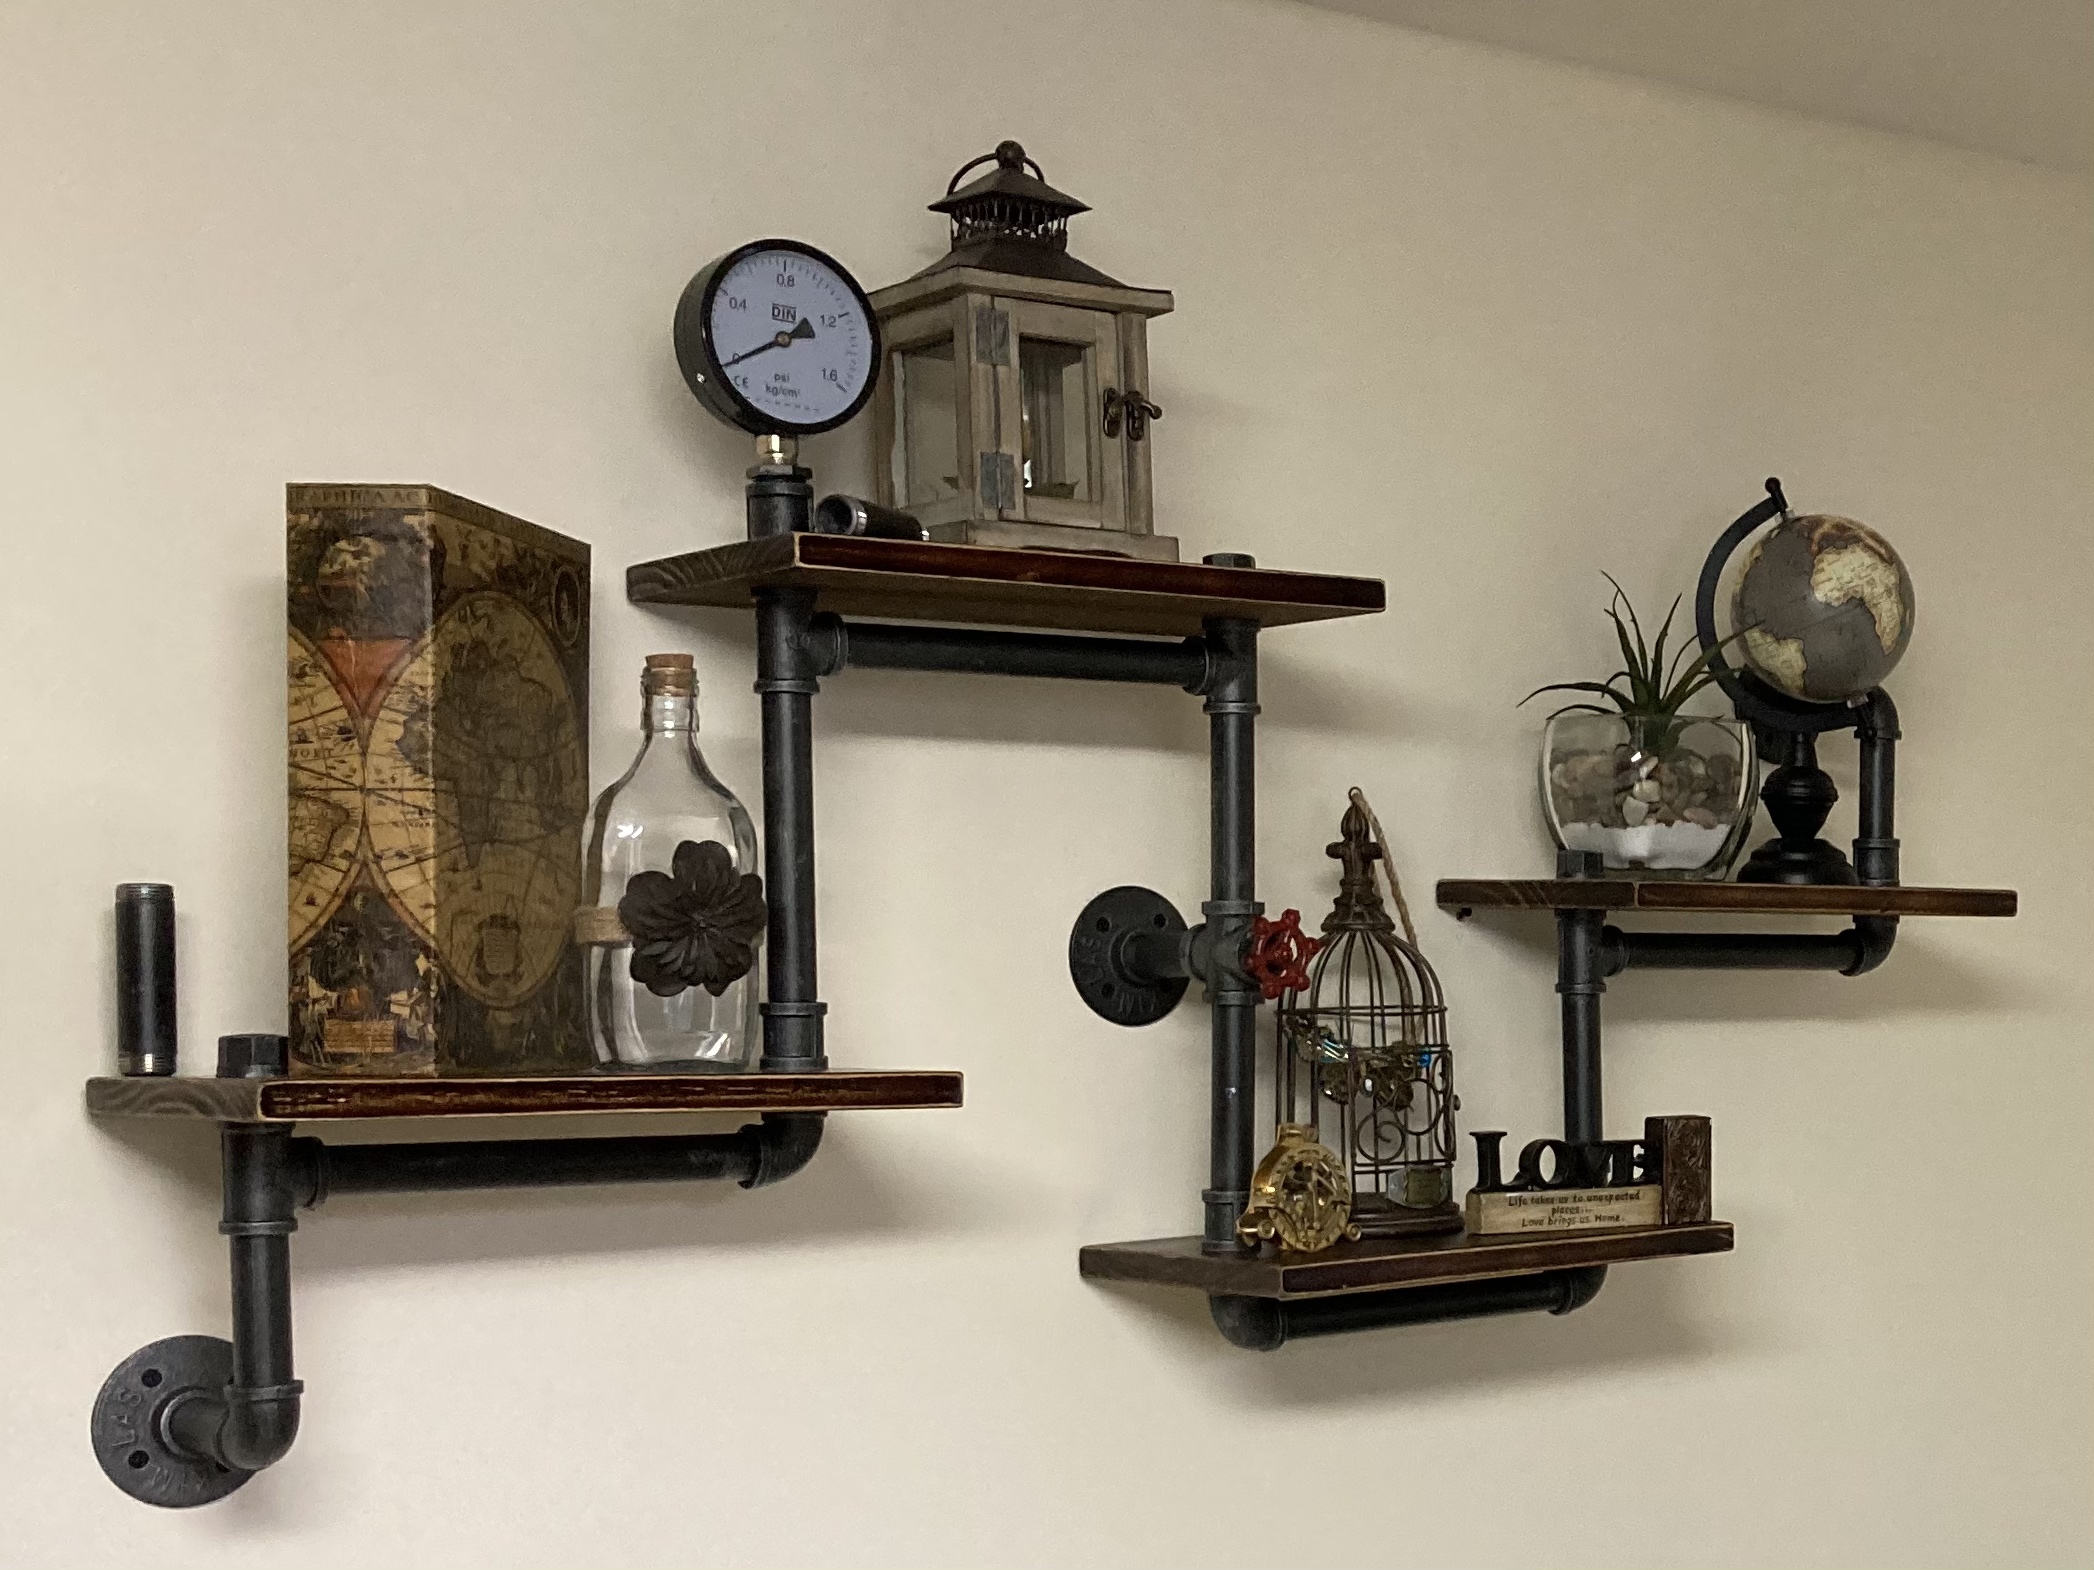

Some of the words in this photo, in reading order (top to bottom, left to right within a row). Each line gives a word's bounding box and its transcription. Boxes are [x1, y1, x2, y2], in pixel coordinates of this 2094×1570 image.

[776, 273, 796, 288] 0.8
[728, 296, 748, 311] 0.4
[771, 303, 797, 323] DIN
[819, 314, 837, 328] 1.2
[820, 366, 838, 382] 1.6
[1468, 1130, 1650, 1190] LOVE
[1508, 1194, 1528, 1207] Life
[1573, 1194, 1584, 1203] to
[1521, 1218, 1545, 1227] Love
